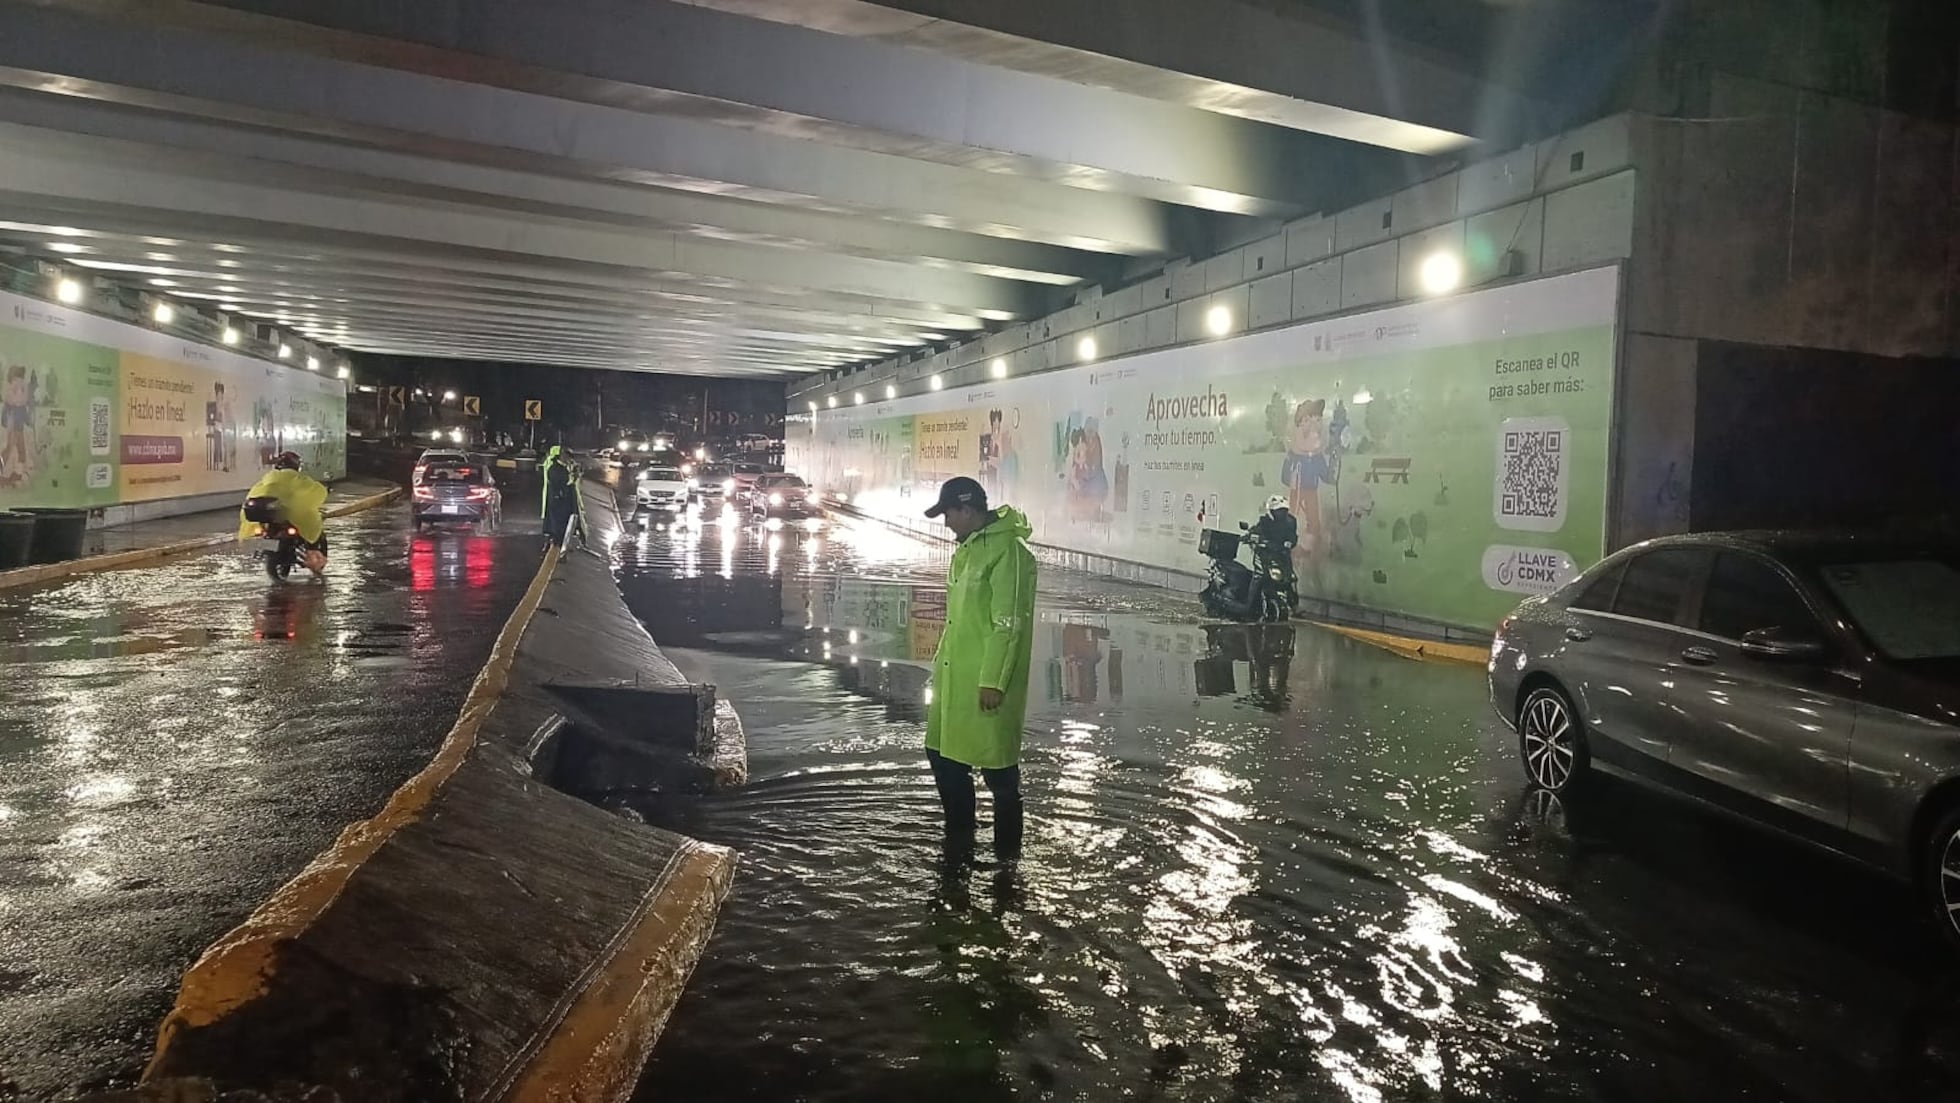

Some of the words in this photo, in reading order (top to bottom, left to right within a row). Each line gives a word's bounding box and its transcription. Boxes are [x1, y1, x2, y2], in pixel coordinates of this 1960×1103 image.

[1495, 358, 1543, 374] Escanea
[1546, 353, 1558, 369] el
[1561, 351, 1580, 370] QR
[1489, 384, 1514, 401] para
[1517, 379, 1551, 396] saber
[1553, 376, 1584, 393] más:
[155, 404, 165, 421] en
[1146, 383, 1228, 431] Aprovecha
[1145, 431, 1168, 451] mejor
[1171, 430, 1180, 446] tu
[1182, 428, 1217, 451] tiempo.
[1518, 552, 1557, 568] LLAVE
[1518, 567, 1556, 582] CDMX
